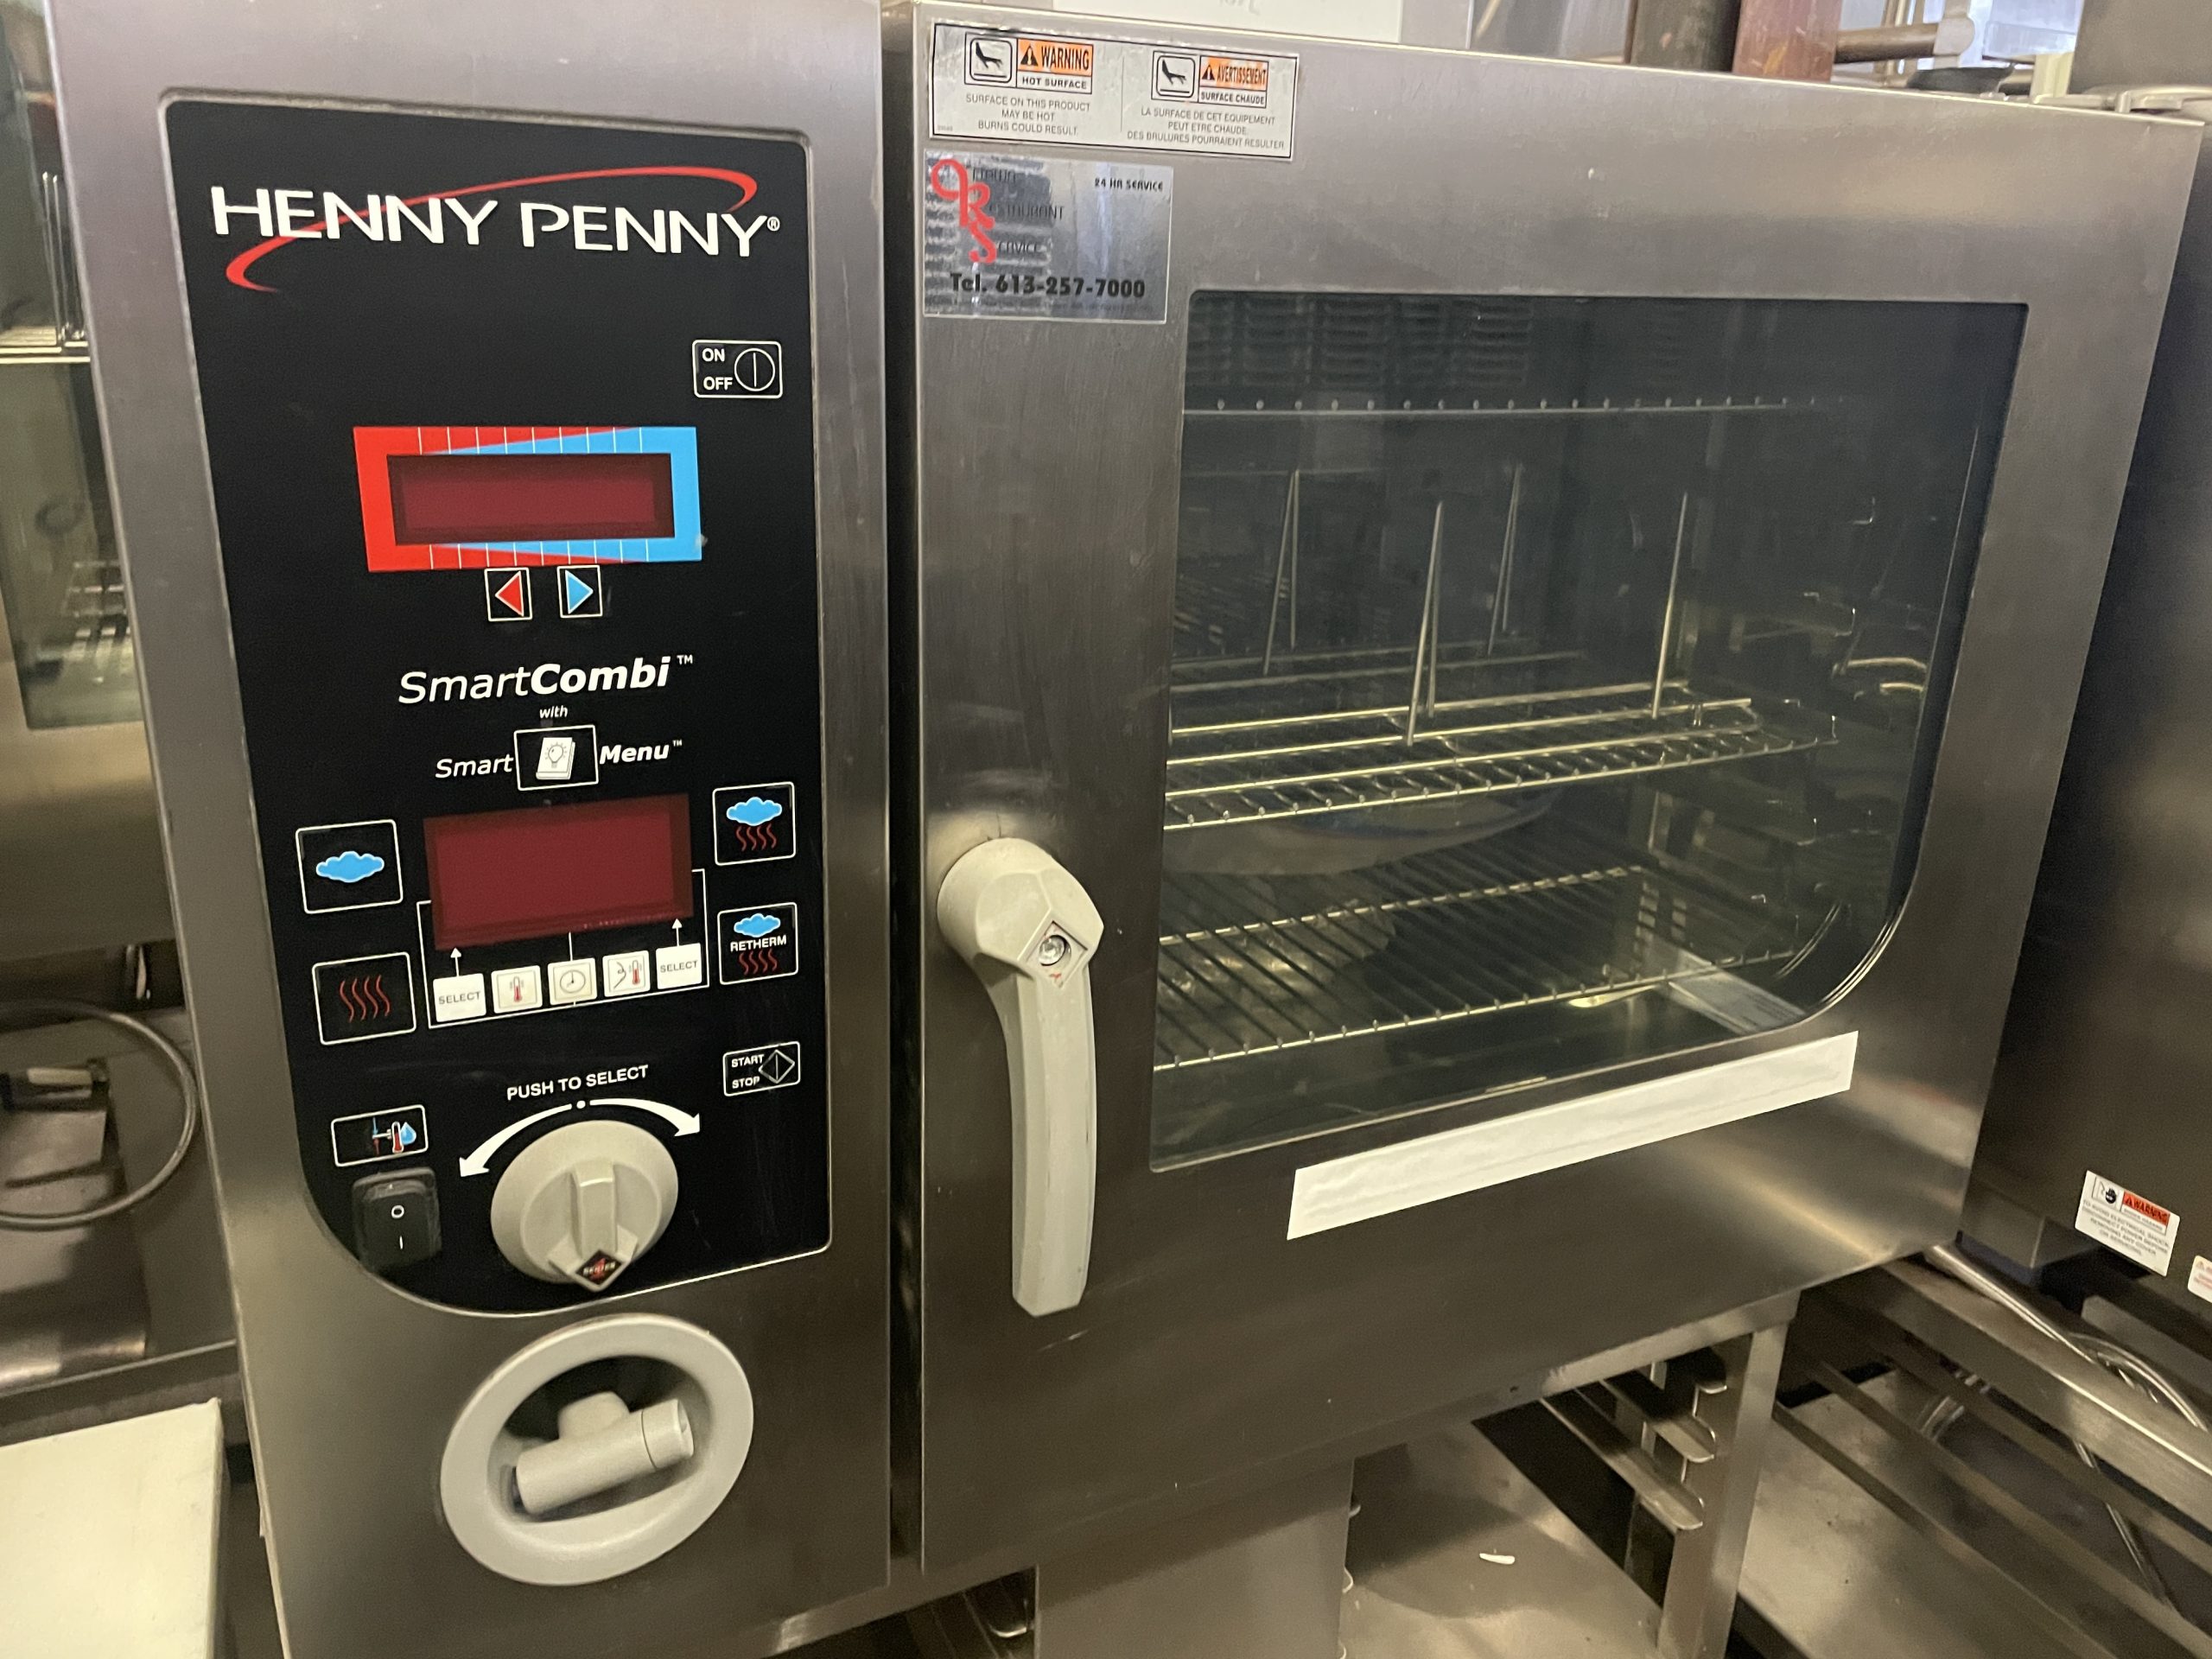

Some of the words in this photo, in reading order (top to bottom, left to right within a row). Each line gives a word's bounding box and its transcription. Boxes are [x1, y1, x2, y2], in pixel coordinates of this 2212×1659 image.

[1041, 46, 1090, 71] WARNING
[1022, 76, 1042, 86] HOT
[1045, 79, 1087, 89] SURFACE
[1217, 66, 1267, 85] AVERTISSEMENT
[966, 93, 1007, 105] SURFACE
[1010, 97, 1024, 106] ON
[1027, 99, 1046, 109] THIS
[1048, 99, 1090, 111] PRODUCT
[1200, 92, 1234, 103] SURFACE
[1235, 94, 1265, 105] CHAUDE
[1001, 109, 1020, 119] MAY
[1022, 111, 1033, 120] BE
[1141, 106, 1151, 117] LA
[1154, 108, 1192, 119] SURFACE
[1193, 111, 1205, 120] DE
[1206, 111, 1223, 122] CET
[1224, 113, 1275, 125] EQUIPEMENT
[978, 120, 1009, 131] BURNS
[1011, 123, 1042, 133] COULD
[1167, 121, 1189, 131] PEUT
[1127, 130, 1144, 140] DES
[1146, 132, 1190, 143] BRULURES
[1192, 134, 1243, 146] POURRAIENT
[1095, 177, 1107, 188] 24
[1109, 178, 1123, 190] HR
[1126, 179, 1163, 193] SERVICE
[211, 186, 499, 245] HENNY
[950, 272, 987, 293] Tel.
[995, 274, 1146, 298] 613-257-7000
[702, 347, 726, 362] ON
[702, 376, 734, 391] OFF
[539, 705, 569, 720] with
[435, 753, 514, 779] Smart
[730, 934, 787, 953] RETHERM
[660, 959, 698, 973] SELECT
[437, 990, 481, 1005] SELECT
[731, 1054, 765, 1068] START
[506, 1080, 554, 1101] PUSH
[557, 1076, 582, 1092] TO
[586, 1065, 649, 1088] SELECT
[732, 1075, 760, 1089] STOP
[2133, 1196, 2168, 1224] WARNING
